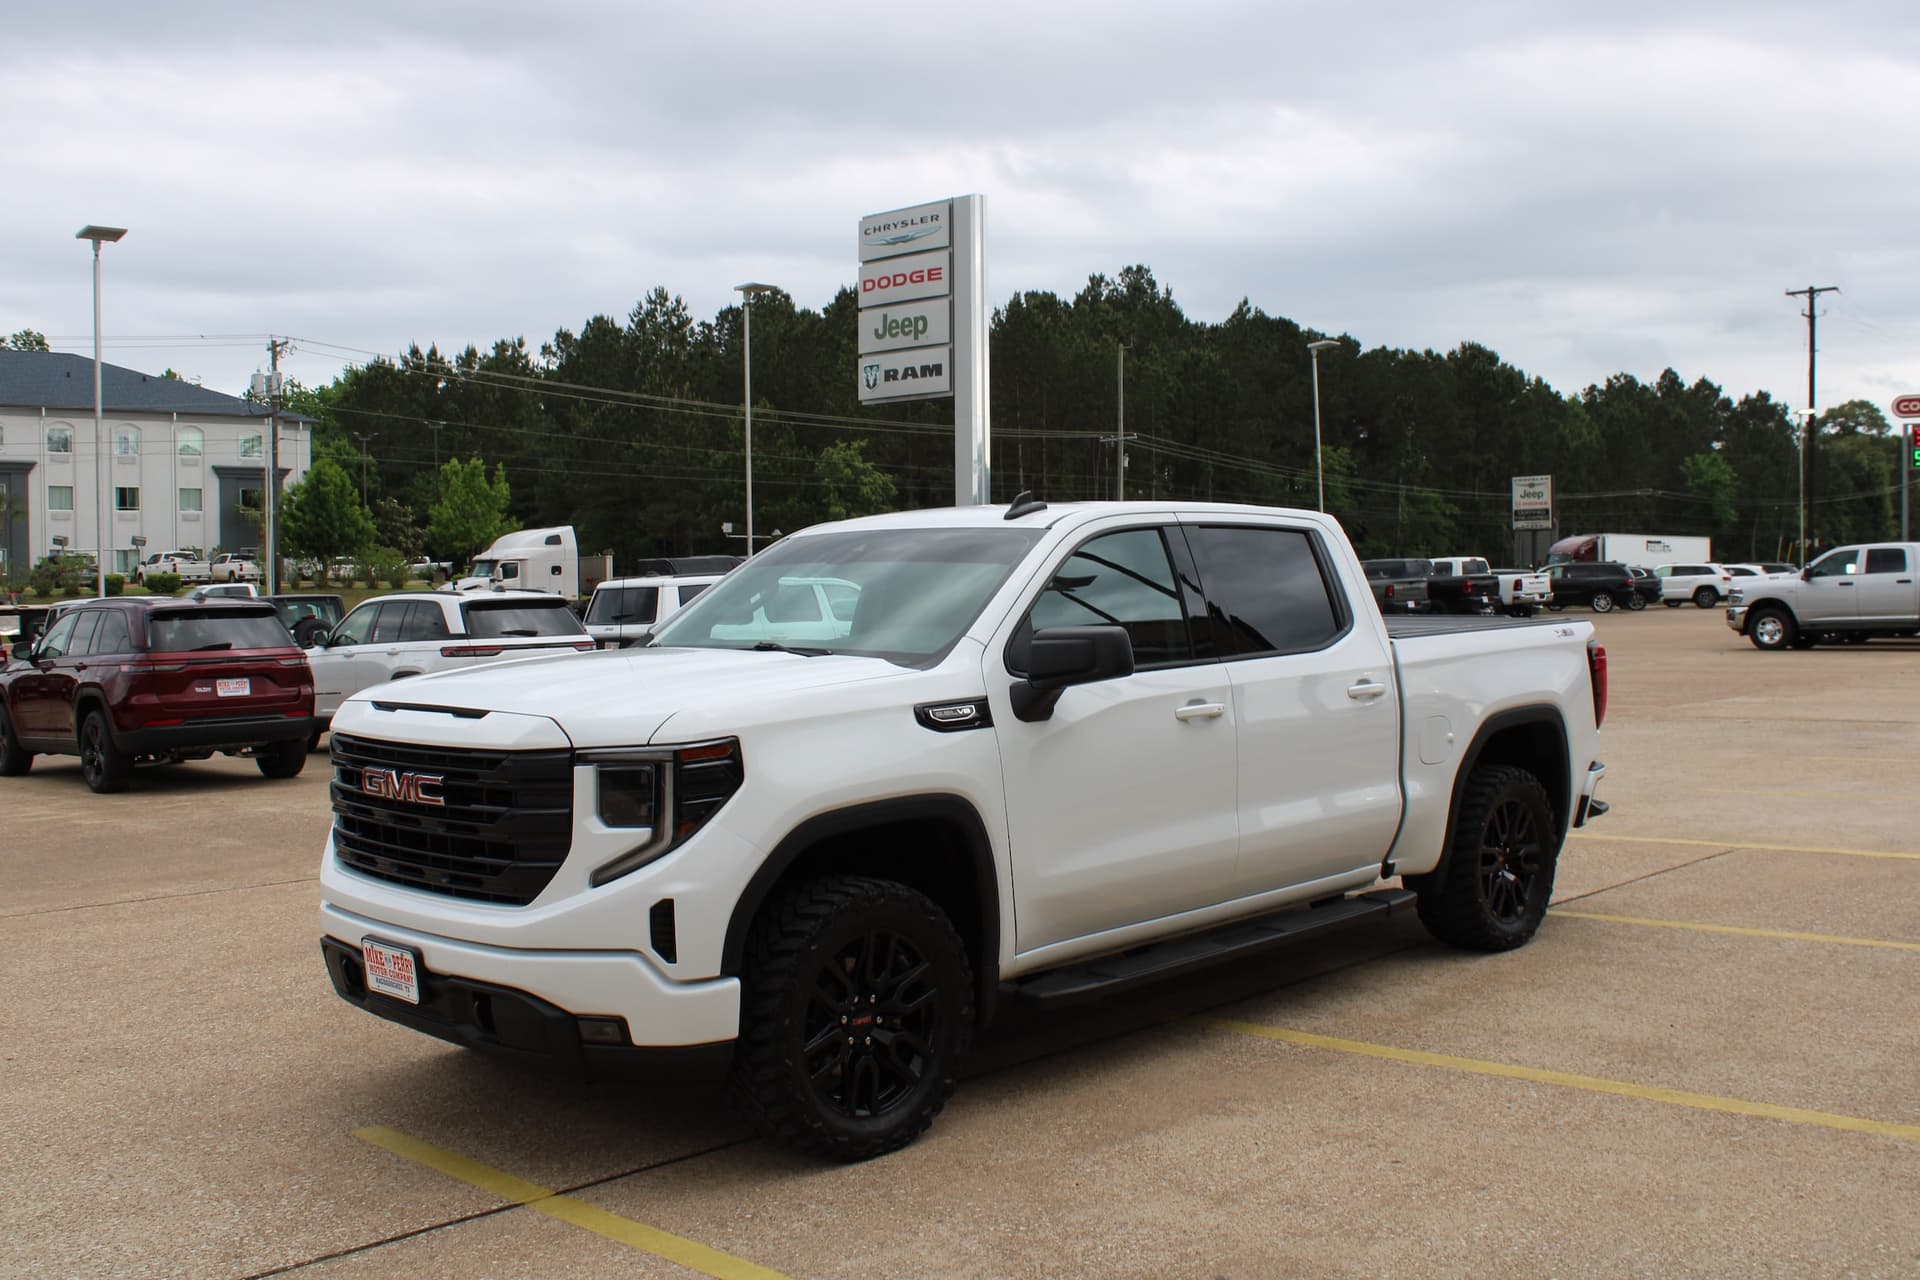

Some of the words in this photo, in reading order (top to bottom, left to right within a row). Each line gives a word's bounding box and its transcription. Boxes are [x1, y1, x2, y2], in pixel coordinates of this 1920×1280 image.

[864, 214, 940, 236] CHRYSLER
[862, 267, 943, 292] DODGE
[874, 313, 928, 340] Jeep
[884, 363, 943, 382] RAM
[1520, 489, 1544, 500] Jeep
[362, 767, 445, 806] GMC
[365, 946, 385, 967] MIKE
[391, 954, 413, 975] PERRY
